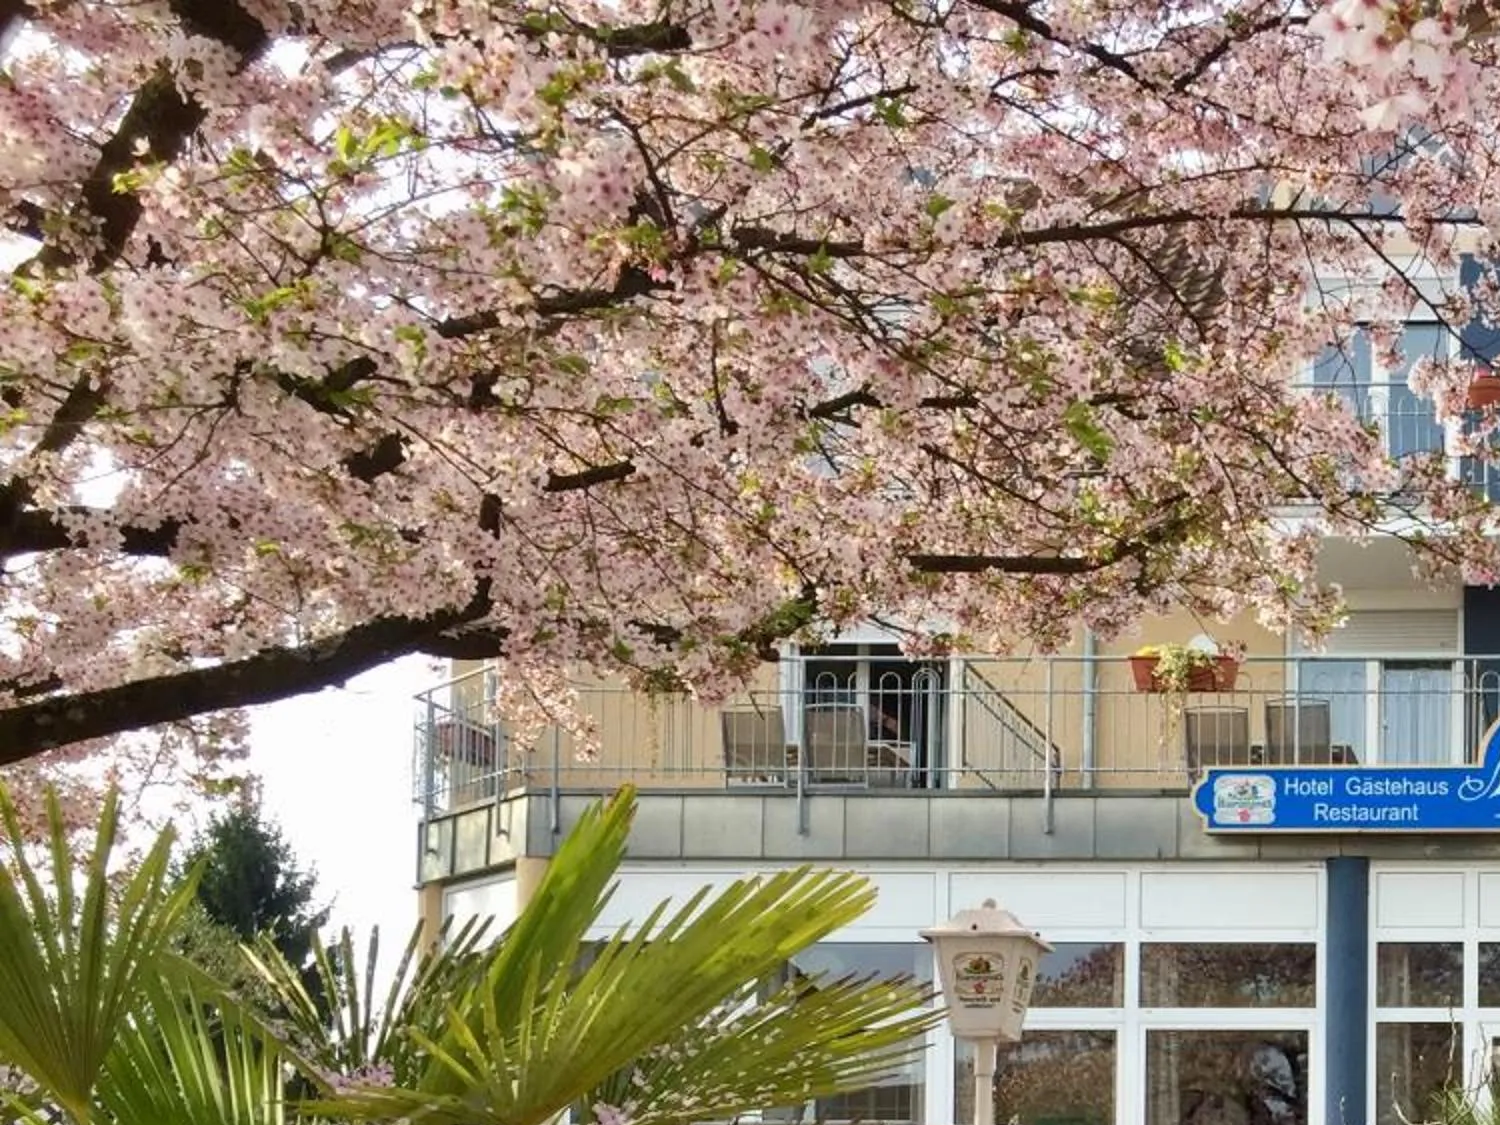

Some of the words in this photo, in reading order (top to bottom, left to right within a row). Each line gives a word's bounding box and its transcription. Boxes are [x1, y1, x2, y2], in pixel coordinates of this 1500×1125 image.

[1284, 777, 1334, 796] Hotel
[1345, 776, 1449, 796] Gästehaus
[1313, 803, 1419, 822] Restaurant
